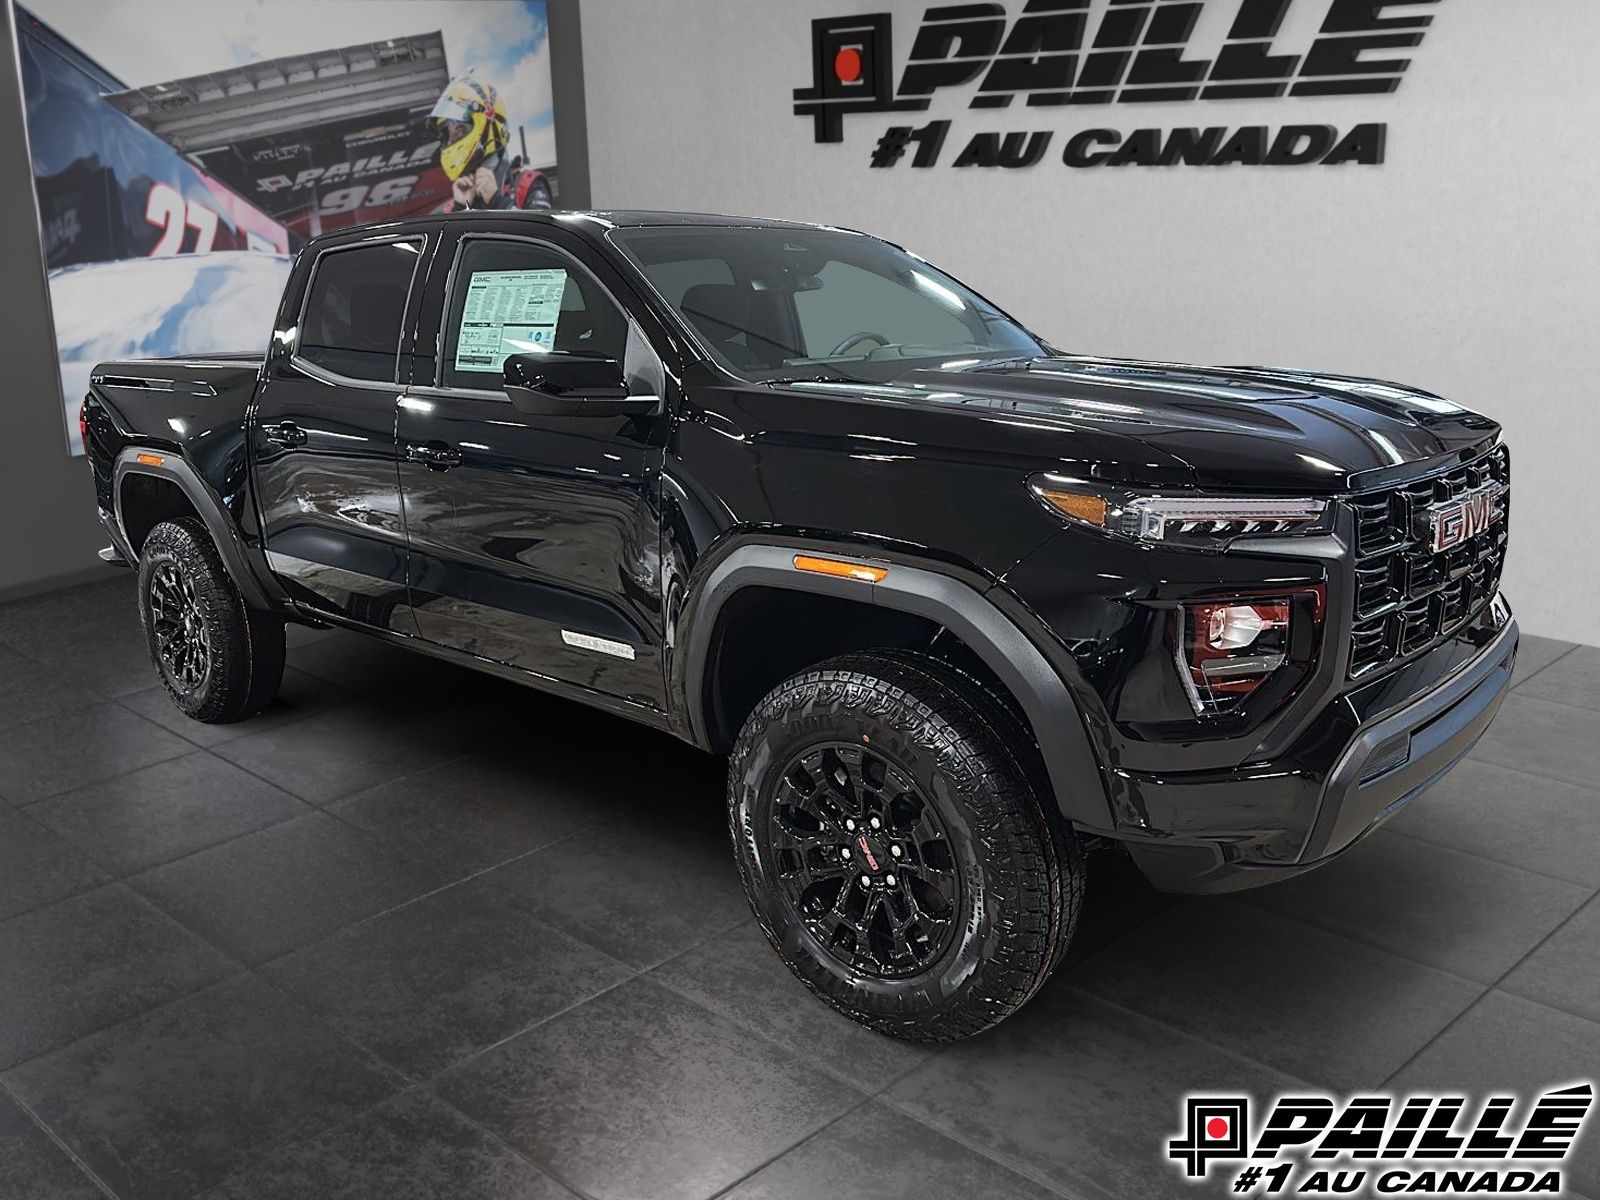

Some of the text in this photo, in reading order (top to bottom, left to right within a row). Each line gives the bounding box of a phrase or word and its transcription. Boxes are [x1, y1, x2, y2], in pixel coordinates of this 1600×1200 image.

[869, 119, 1387, 168] #1 AU CANADA
[145, 181, 219, 257] 27
[319, 175, 420, 216] 96
[1430, 481, 1509, 554] GMC
[858, 836, 880, 870] GMC
